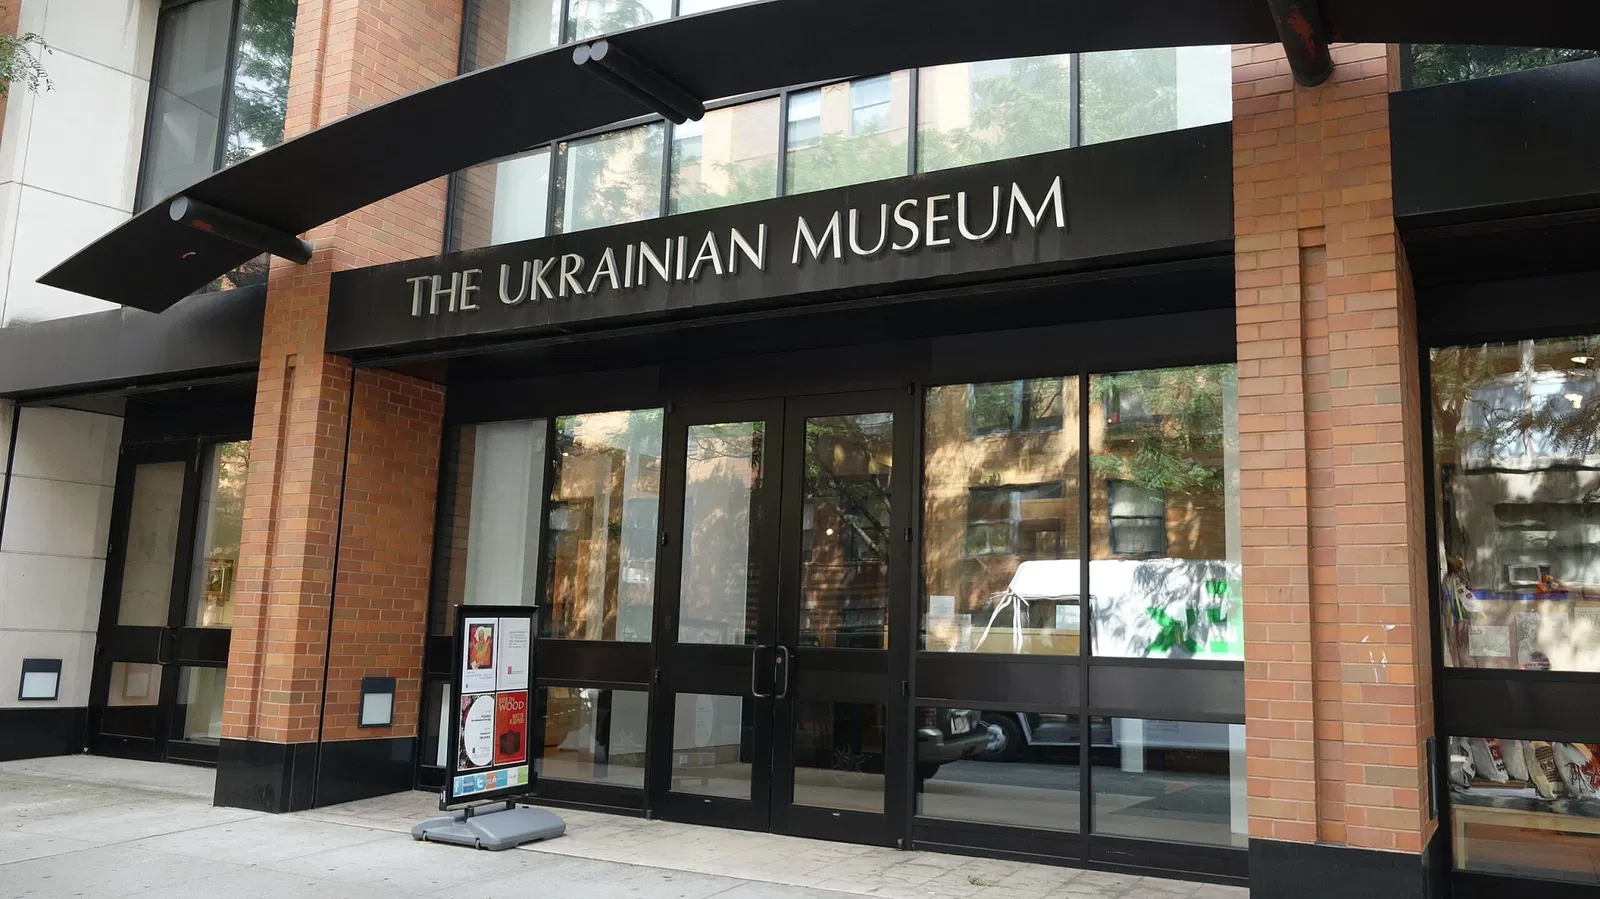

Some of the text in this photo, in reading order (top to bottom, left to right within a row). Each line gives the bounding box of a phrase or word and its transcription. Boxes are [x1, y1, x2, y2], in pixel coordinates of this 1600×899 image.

[406, 175, 1066, 316] THE UKRAINIAN MUSEUM
[498, 700, 525, 711] WOOD
